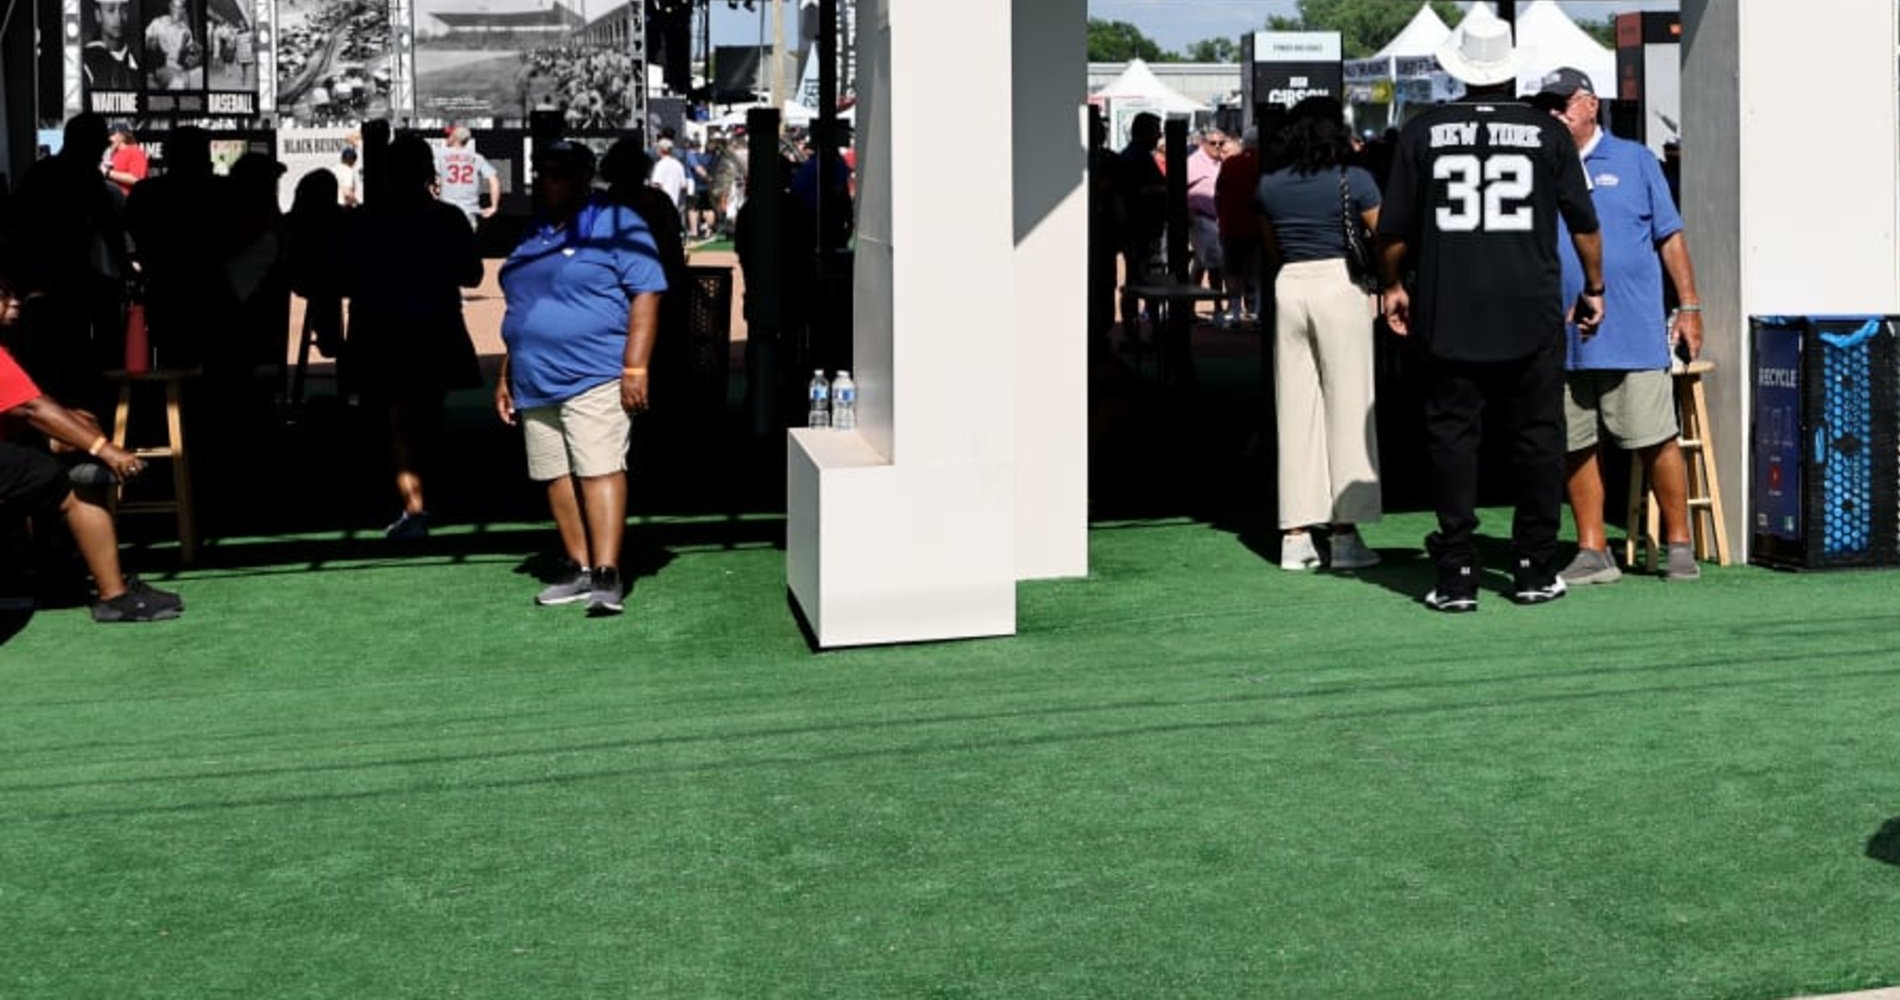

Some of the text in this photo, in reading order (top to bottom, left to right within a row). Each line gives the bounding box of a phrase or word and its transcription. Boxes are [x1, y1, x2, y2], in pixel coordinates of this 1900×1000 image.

[91, 91, 138, 113] WARTIME
[207, 93, 254, 114] BASEBALL
[1430, 121, 1542, 148] NEW YORK
[284, 138, 313, 155] BLACK
[446, 163, 474, 184] 32
[1432, 154, 1534, 232] 32
[1758, 367, 1797, 389] RECYCLE
